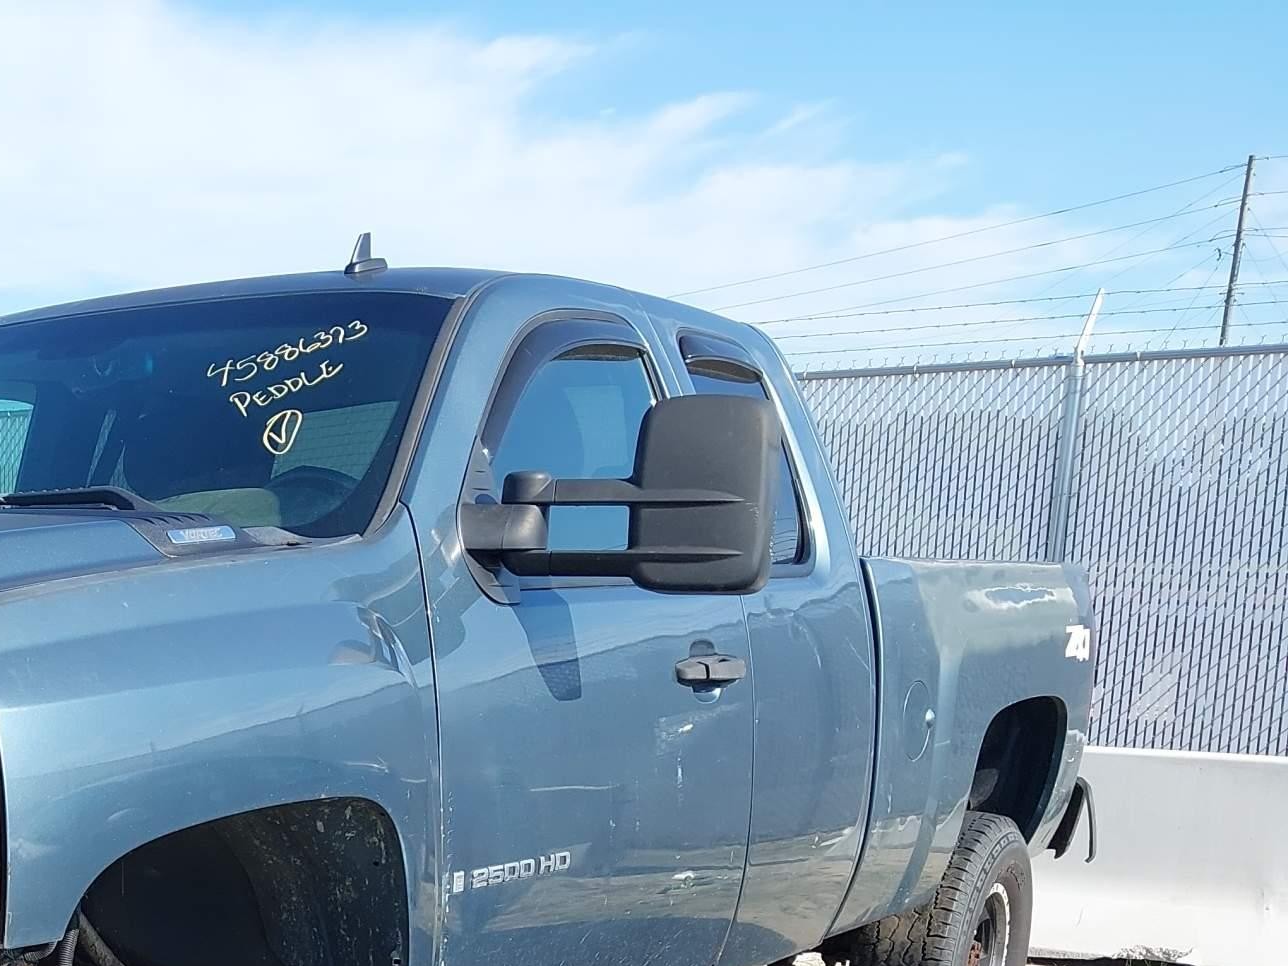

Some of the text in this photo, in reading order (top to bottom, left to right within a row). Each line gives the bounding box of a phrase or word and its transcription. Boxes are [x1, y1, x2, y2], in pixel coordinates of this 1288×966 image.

[207, 319, 369, 387] 45886373
[229, 359, 344, 418] PEDDLE
[471, 851, 572, 889] 2500 HD
